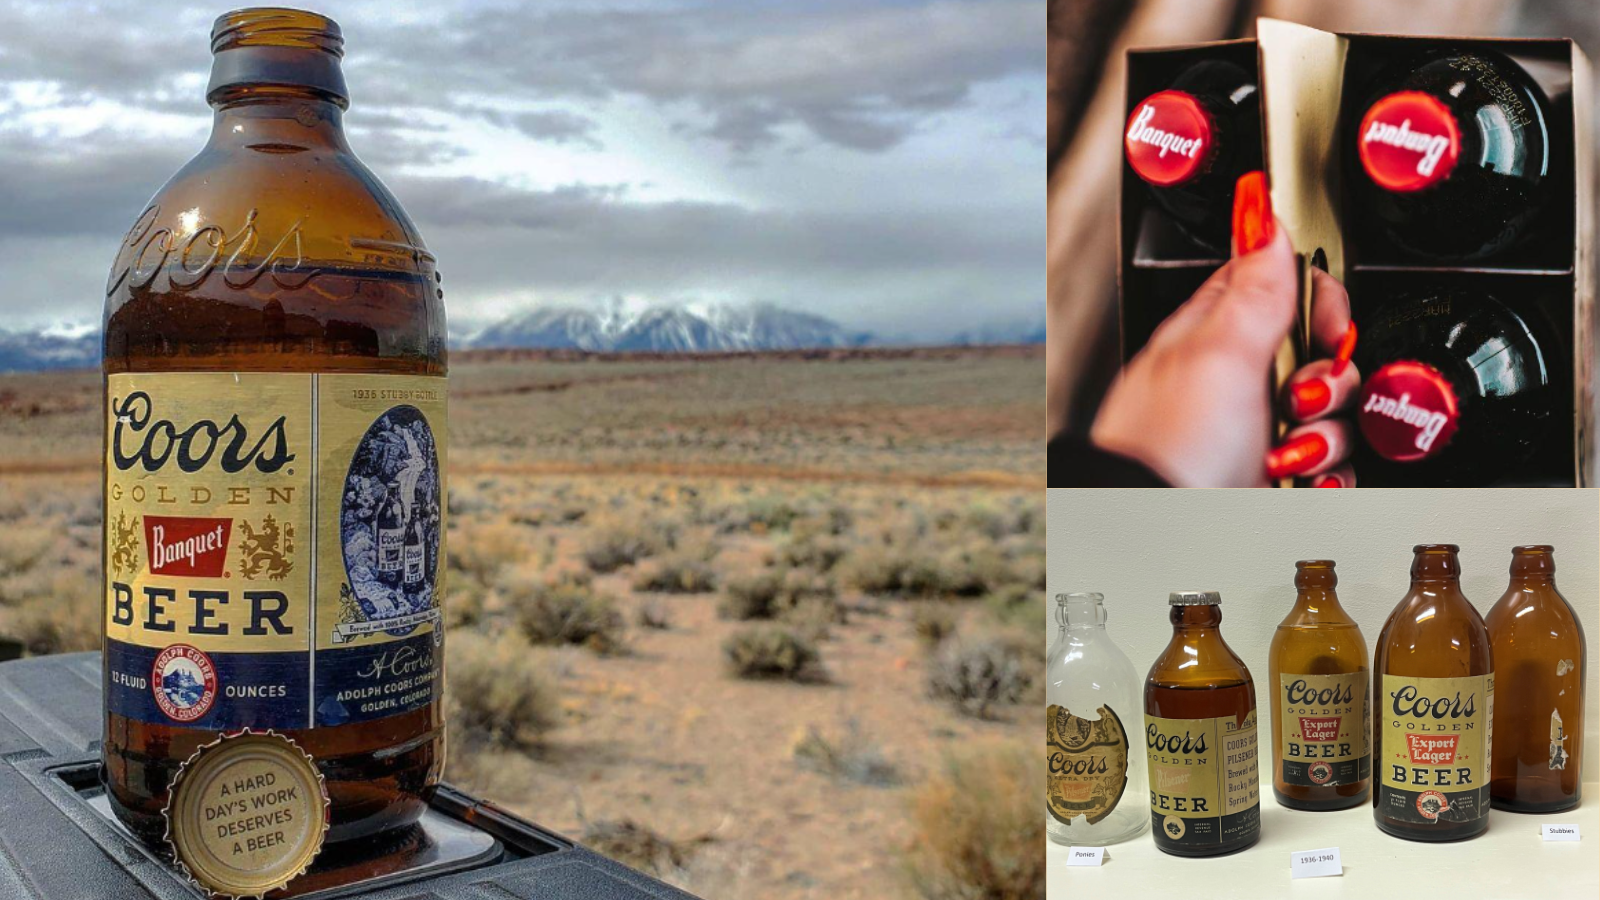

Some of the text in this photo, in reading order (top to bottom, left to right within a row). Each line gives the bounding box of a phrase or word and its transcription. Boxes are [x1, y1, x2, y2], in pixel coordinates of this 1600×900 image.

[1127, 104, 1202, 159] Banquet
[1365, 119, 1449, 178] Banquet
[106, 205, 320, 296] Coors
[352, 389, 377, 399] 1936
[381, 389, 414, 399] STUBBY
[113, 391, 296, 474] Coors
[1363, 392, 1448, 452] Banquet
[112, 483, 296, 505] GOLDEN
[152, 524, 224, 569] Banquet
[112, 581, 294, 636] BEER
[112, 670, 147, 690] 12 FLUID
[337, 686, 381, 702] ADOLPH
[384, 678, 413, 694] COORS
[225, 685, 287, 698] OUNCES
[400, 686, 431, 705] COLORADO
[1285, 679, 1353, 706] Coors
[1390, 685, 1477, 719] Coors
[1287, 707, 1352, 715] GOLDEN
[1302, 719, 1338, 731] Export
[1304, 729, 1336, 741] Lager
[1392, 720, 1475, 731] GOLDEN
[1146, 723, 1209, 754] Coors
[1227, 738, 1247, 751] COORS
[1409, 735, 1455, 752] Export
[1227, 747, 1254, 765] PILSENER
[1288, 743, 1352, 758] BEER
[1411, 748, 1452, 764] Lager
[1047, 752, 1109, 775] Coors
[1228, 766, 1249, 779] Brewed
[221, 773, 276, 797] A HARD
[1157, 768, 1191, 789] Pilsener
[1391, 764, 1472, 786] BEER
[1228, 781, 1248, 793] Rocky
[205, 787, 298, 821] DAY'S WORK
[1150, 790, 1209, 812] BEER
[1228, 796, 1248, 808] Spring
[217, 809, 293, 839] DESERVES
[232, 831, 286, 856] A BEER
[1300, 854, 1335, 864] 1936-1940
